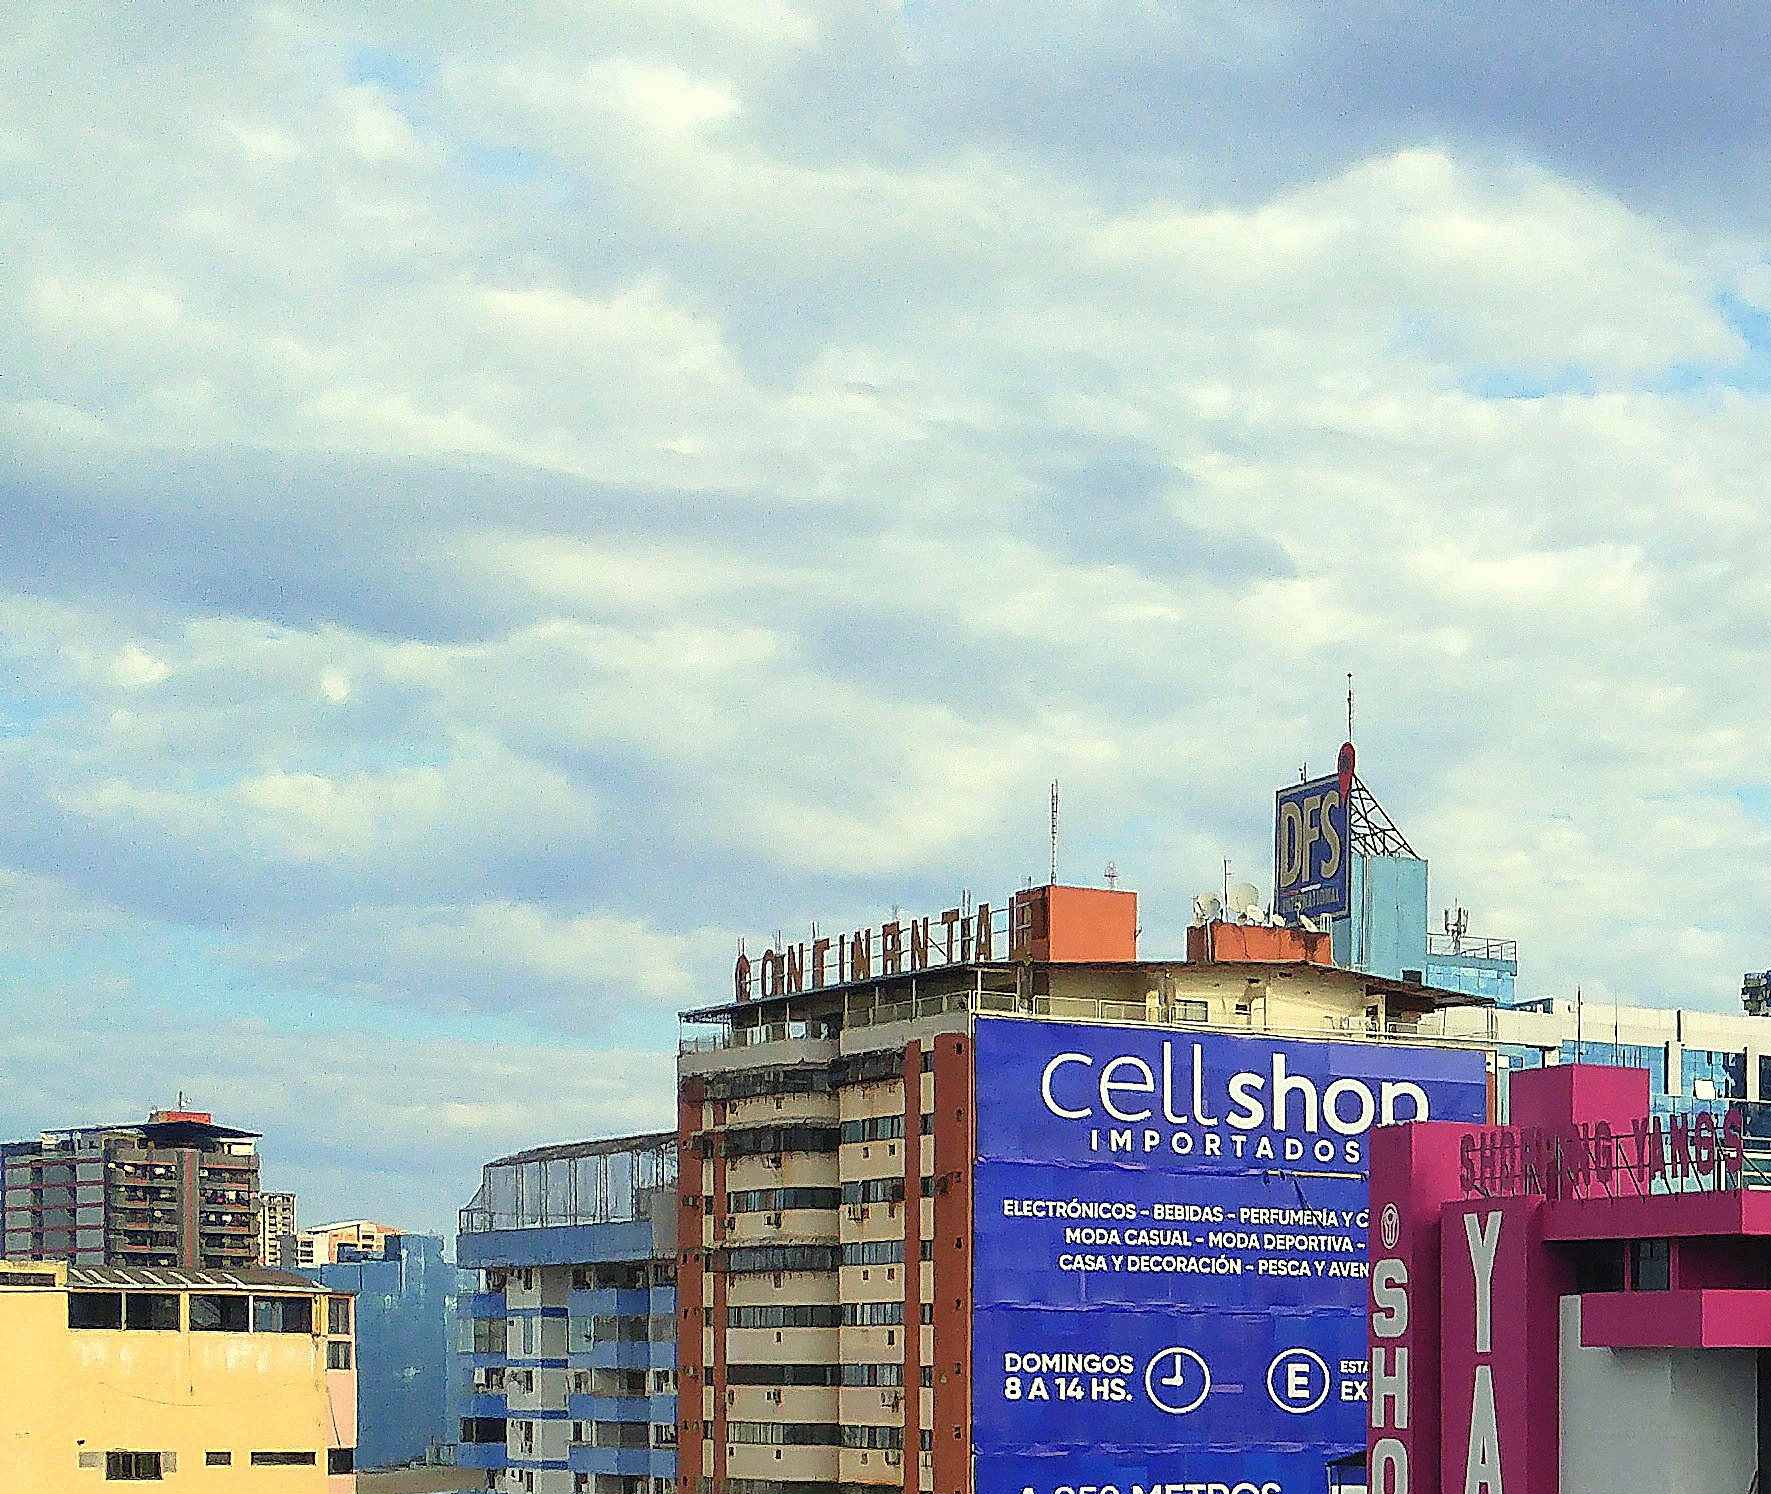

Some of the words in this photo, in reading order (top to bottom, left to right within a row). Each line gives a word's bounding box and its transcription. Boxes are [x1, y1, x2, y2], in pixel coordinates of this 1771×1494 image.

[1280, 790, 1341, 889] DFS
[1091, 1129, 1361, 1163] IMPORTADOS
[1003, 1198, 1136, 1220] ELECTRÓNICOS
[1154, 1204, 1223, 1224] BEBIDAS
[1240, 1206, 1338, 1229] PERFUMERÍA
[1342, 1211, 1353, 1227] Y
[1065, 1228, 1120, 1246] MODA
[1125, 1229, 1192, 1248] CASUAL
[1208, 1233, 1261, 1251] MODA
[1264, 1235, 1354, 1253] DEPORTIVA
[1059, 1254, 1108, 1272] CASA
[1111, 1255, 1123, 1272] Y
[1127, 1253, 1242, 1275] DECORACIÓN
[1258, 1259, 1311, 1277] PESCA
[1314, 1260, 1326, 1277] Y
[1004, 1352, 1134, 1374] DOMINGOS
[1004, 1378, 1021, 1401] 8
[1027, 1379, 1049, 1400] A
[1055, 1378, 1084, 1401] 14
[1092, 1379, 1133, 1402] HS.
[1287, 1363, 1310, 1398] E
